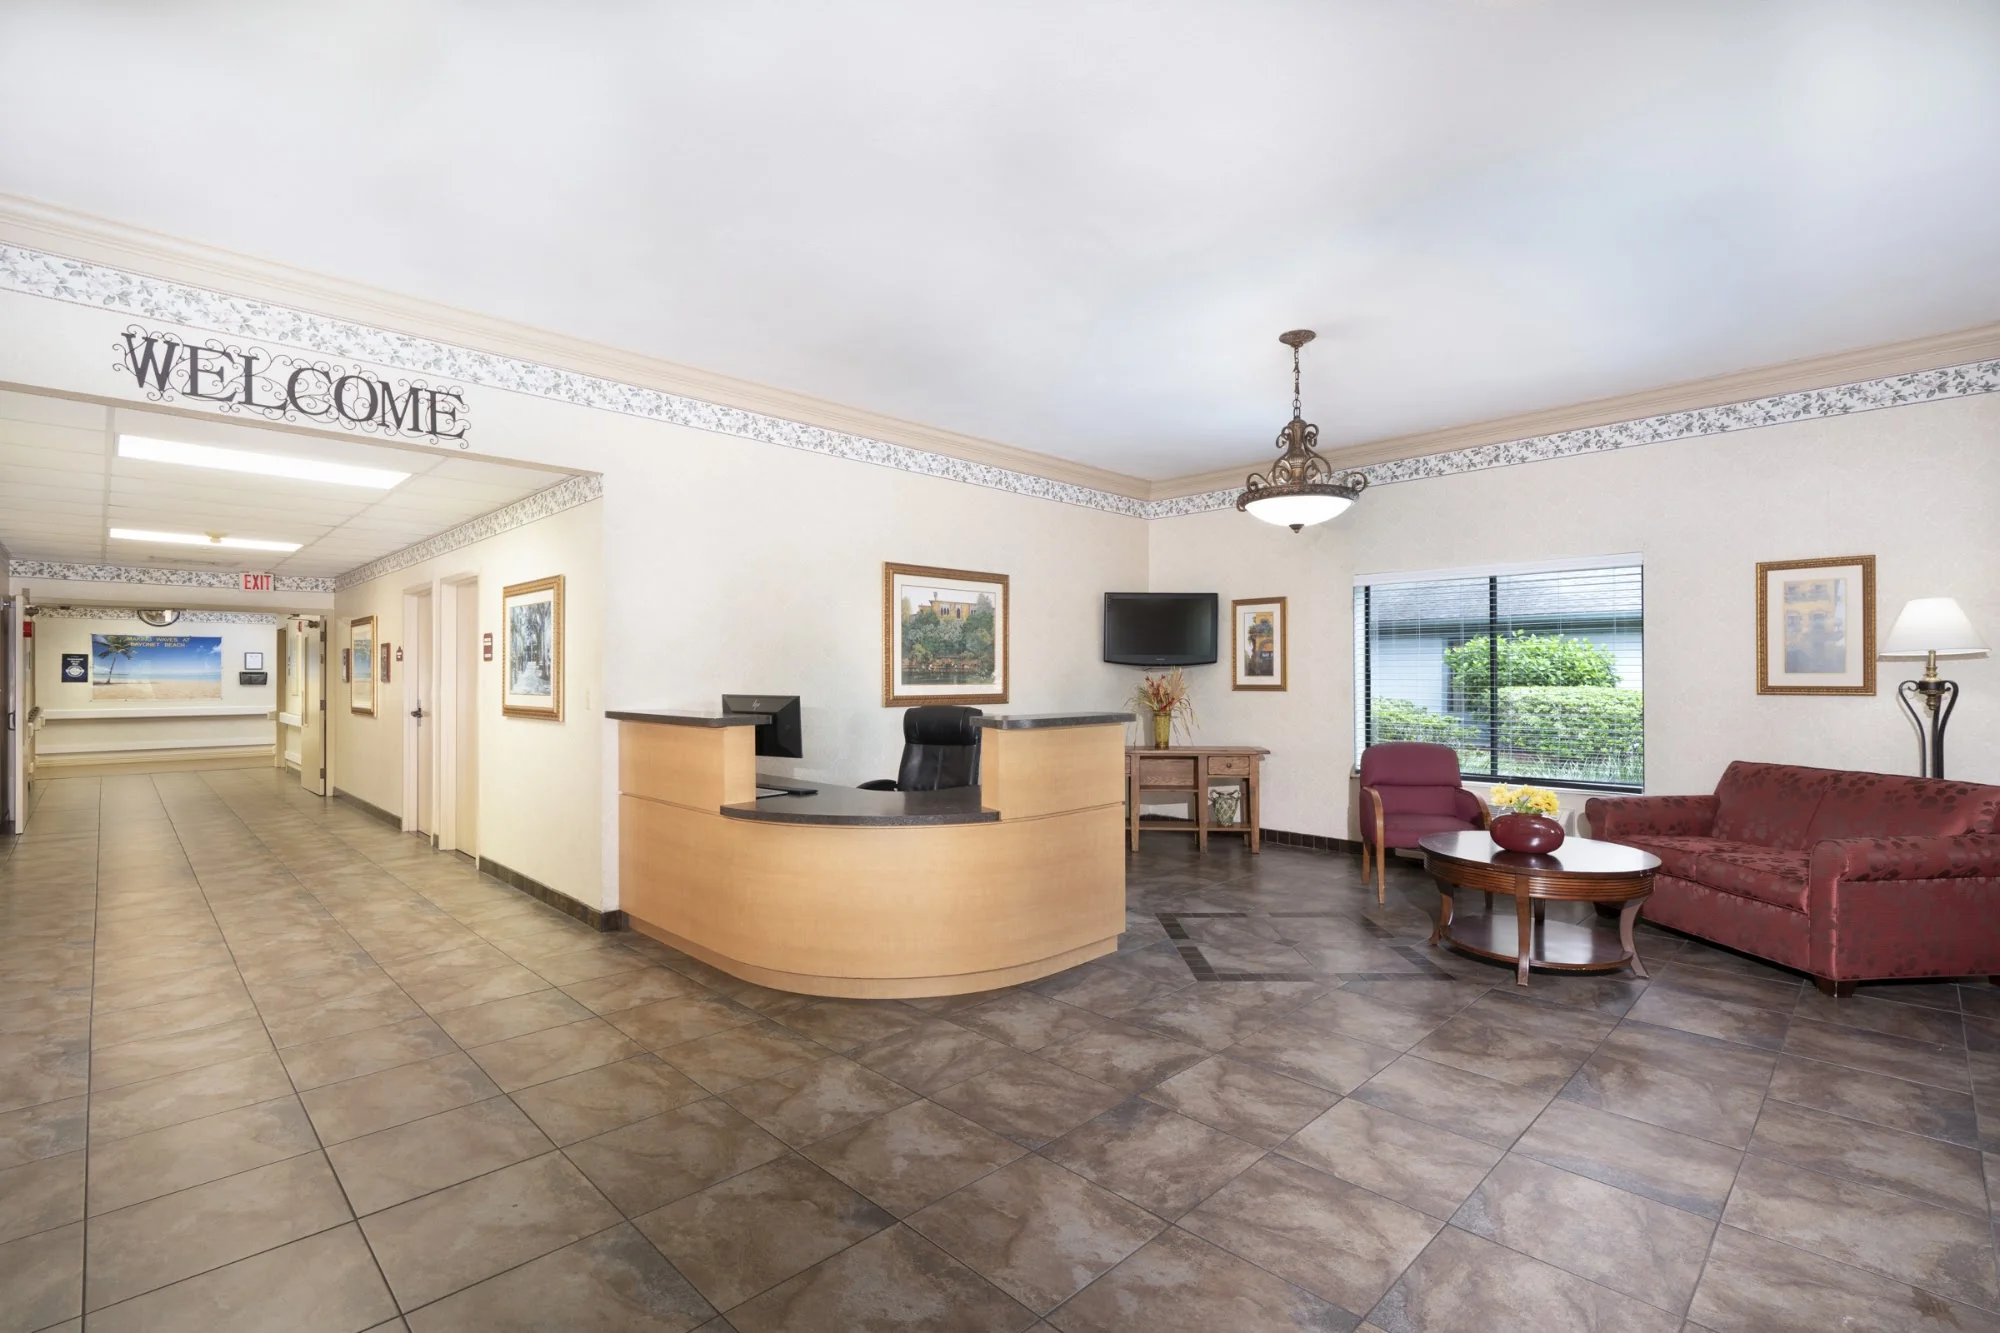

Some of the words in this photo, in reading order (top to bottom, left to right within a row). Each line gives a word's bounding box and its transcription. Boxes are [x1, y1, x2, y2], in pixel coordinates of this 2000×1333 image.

[117, 329, 468, 443] WELCOME
[244, 574, 271, 590] EXIT
[752, 699, 760, 711] hp
